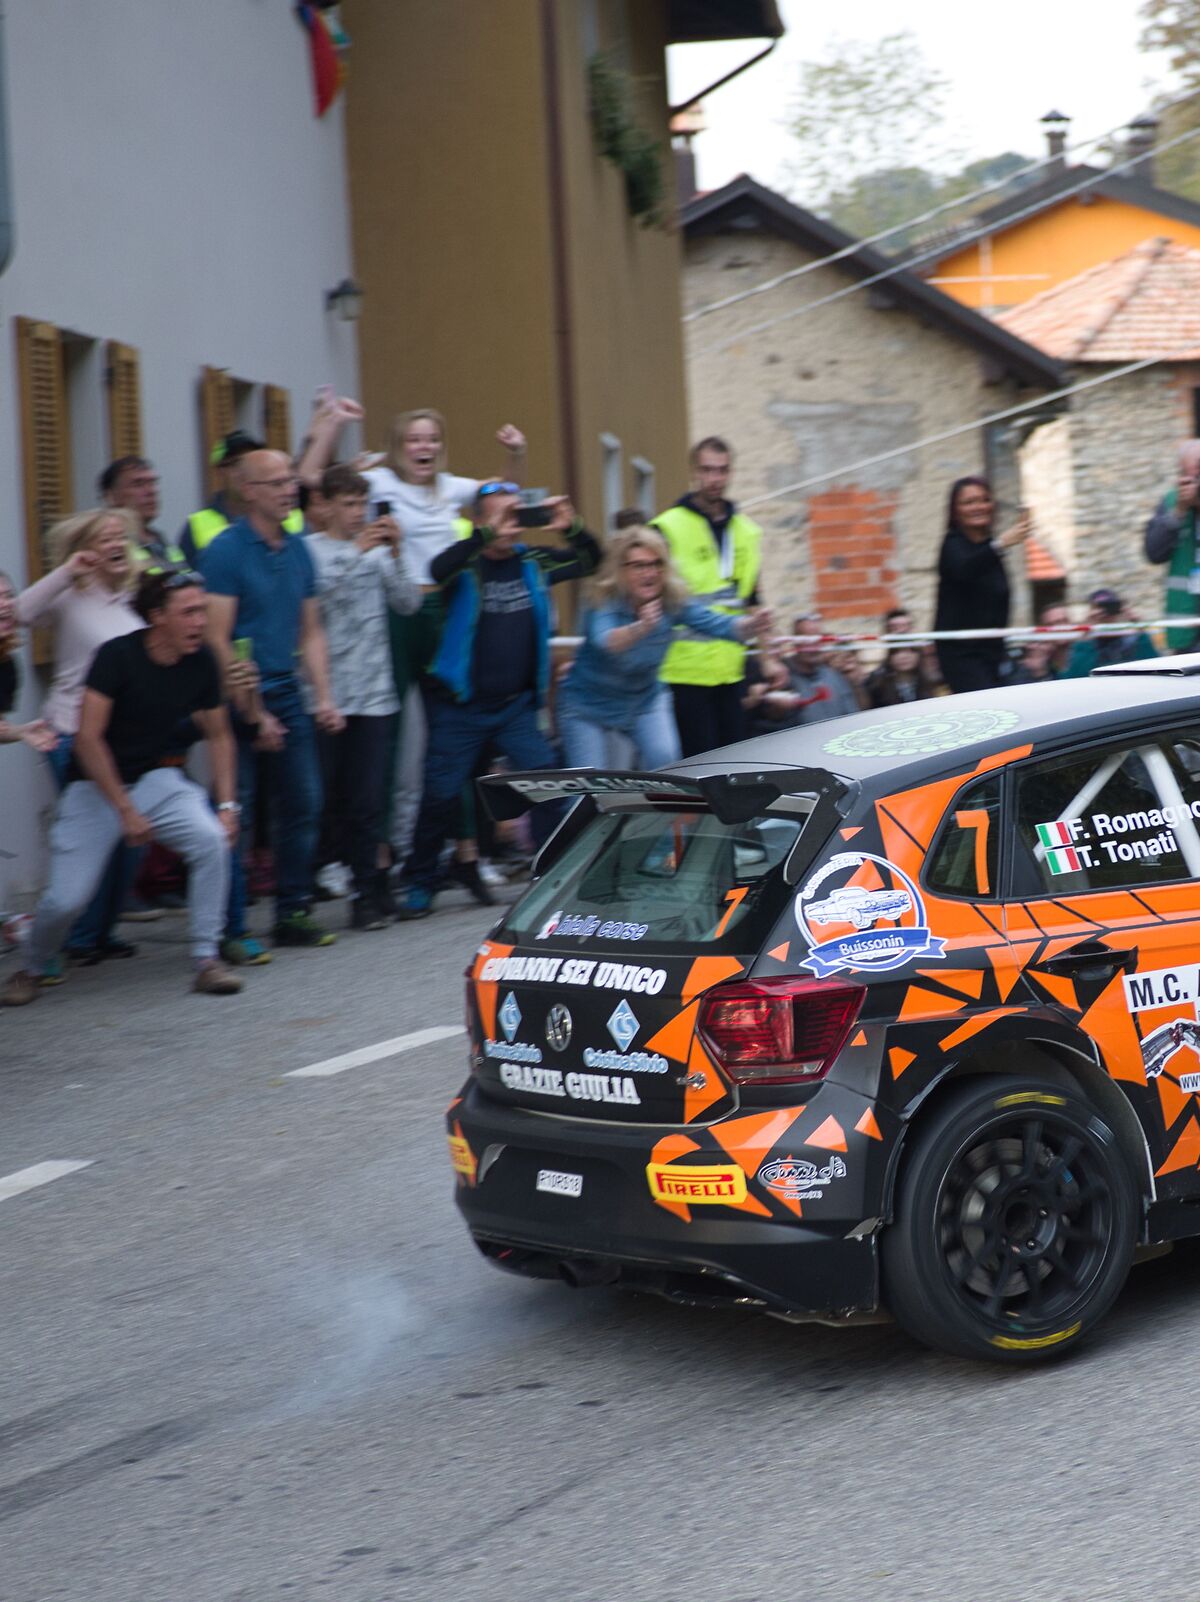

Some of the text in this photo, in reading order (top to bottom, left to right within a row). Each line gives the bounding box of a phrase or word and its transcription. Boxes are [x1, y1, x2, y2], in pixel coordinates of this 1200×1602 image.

[1067, 818, 1090, 841] F.
[955, 809, 990, 894] 7
[1076, 831, 1178, 868] T. Tonati
[553, 914, 649, 941] biella corse
[838, 934, 905, 956] Buissonin
[480, 956, 668, 995] GIOVANNI SEI UNICO
[1129, 973, 1189, 1008] M.C.
[500, 1062, 567, 1097] GRAZIE
[565, 1072, 641, 1105] GIULIA
[655, 1172, 735, 1196] PIRELLI
